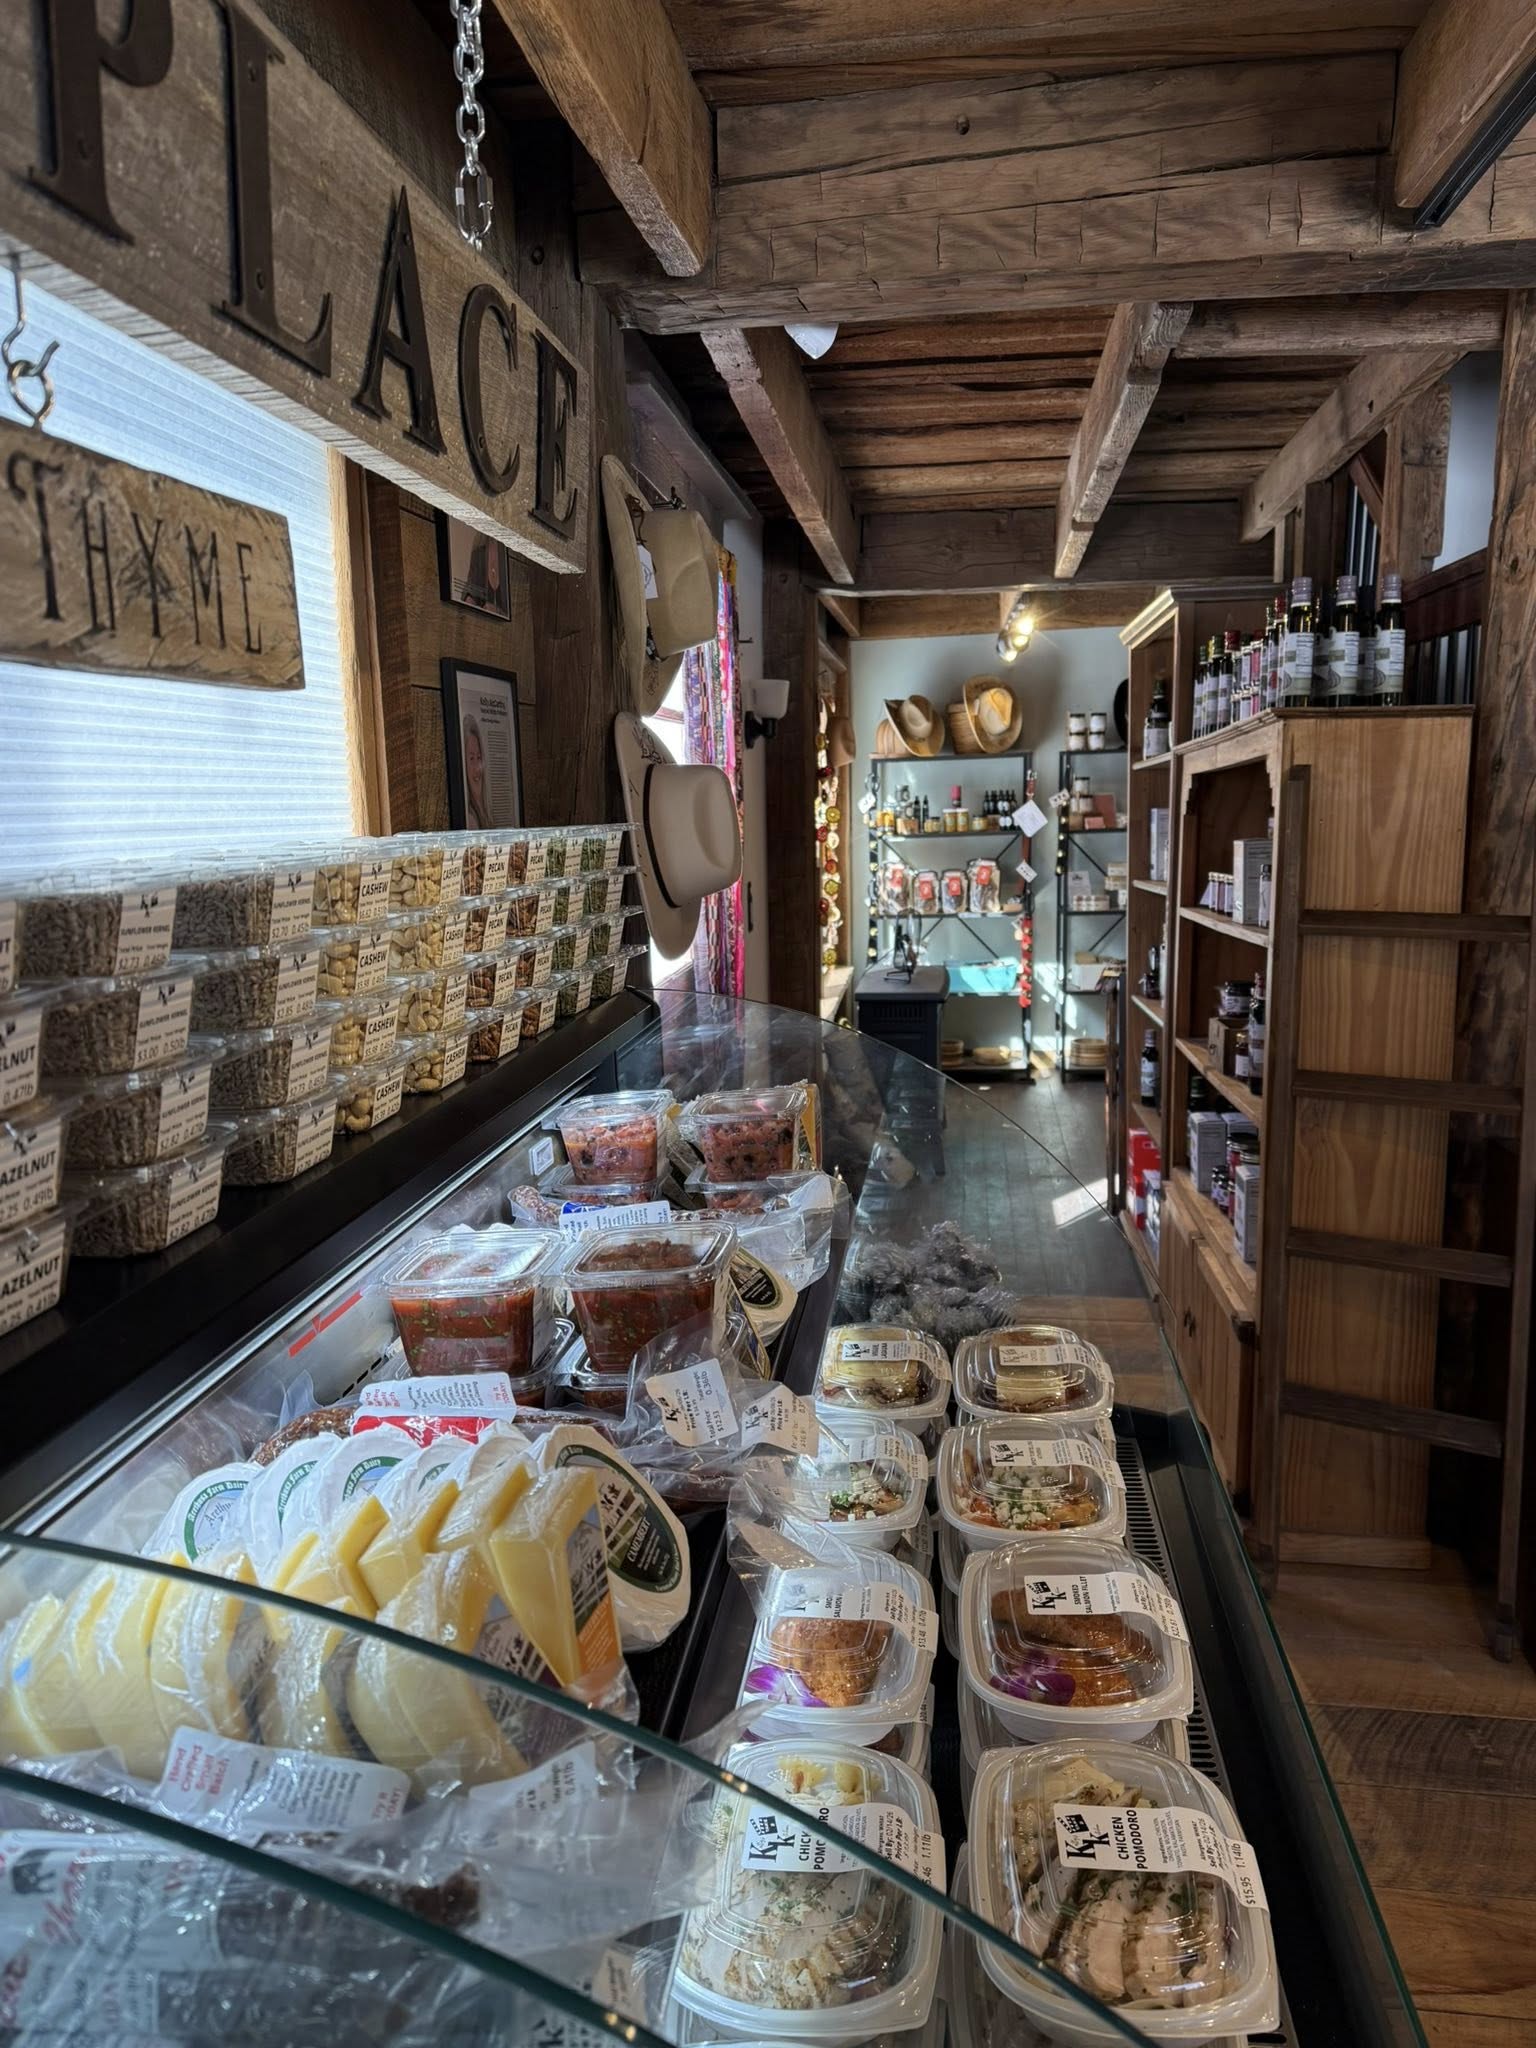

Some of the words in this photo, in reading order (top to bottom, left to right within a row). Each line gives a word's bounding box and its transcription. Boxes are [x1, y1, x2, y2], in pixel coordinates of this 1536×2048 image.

[6, 0, 578, 541] PLACE
[8, 452, 266, 655] THYME
[443, 866, 461, 881] CASHEW
[488, 862, 505, 873] PECAN
[361, 881, 389, 897] CASHEW
[445, 928, 464, 942] CASHEW
[359, 952, 386, 968] CASHEW
[446, 987, 465, 1004] CASHEW
[367, 1018, 396, 1035] CASHEW
[445, 1047, 465, 1066] CASHEW
[376, 1079, 401, 1101] CASHEW
[701, 1371, 712, 1395] 0.36lb
[688, 1413, 696, 1428] Price
[713, 1411, 724, 1432] $12.53
[707, 1425, 716, 1438] Total
[626, 1516, 651, 1562] CAMEMBERT
[1080, 1576, 1088, 1591] FILLET
[1071, 1584, 1082, 1605] SMOKED
[1083, 1592, 1093, 1613] SALMON
[834, 1596, 843, 1618] SALMON
[918, 1610, 927, 1626] 0.47lb
[918, 1630, 926, 1648] $13.48
[168, 1748, 186, 1782] Hand
[181, 1745, 202, 1792] Crafted
[195, 1755, 214, 1789] Small
[208, 1759, 230, 1794] Batch
[563, 1762, 576, 1795] 0.41lb
[886, 1811, 894, 1836] 02/14/26
[895, 1817, 903, 1828] LB:
[886, 1837, 895, 1847] By:
[921, 1834, 931, 1858] 1.11lb
[1111, 1817, 1129, 1860] CHICKEN
[1126, 1809, 1149, 1870] POMODORO
[885, 1848, 894, 1860] Sell
[1158, 1837, 1168, 1864] Ingredients:
[1206, 1844, 1215, 1855] By:
[1231, 1843, 1246, 1868] 1.14lb
[1209, 1856, 1218, 1868] Sell
[1240, 1876, 1256, 1905] $15.95
